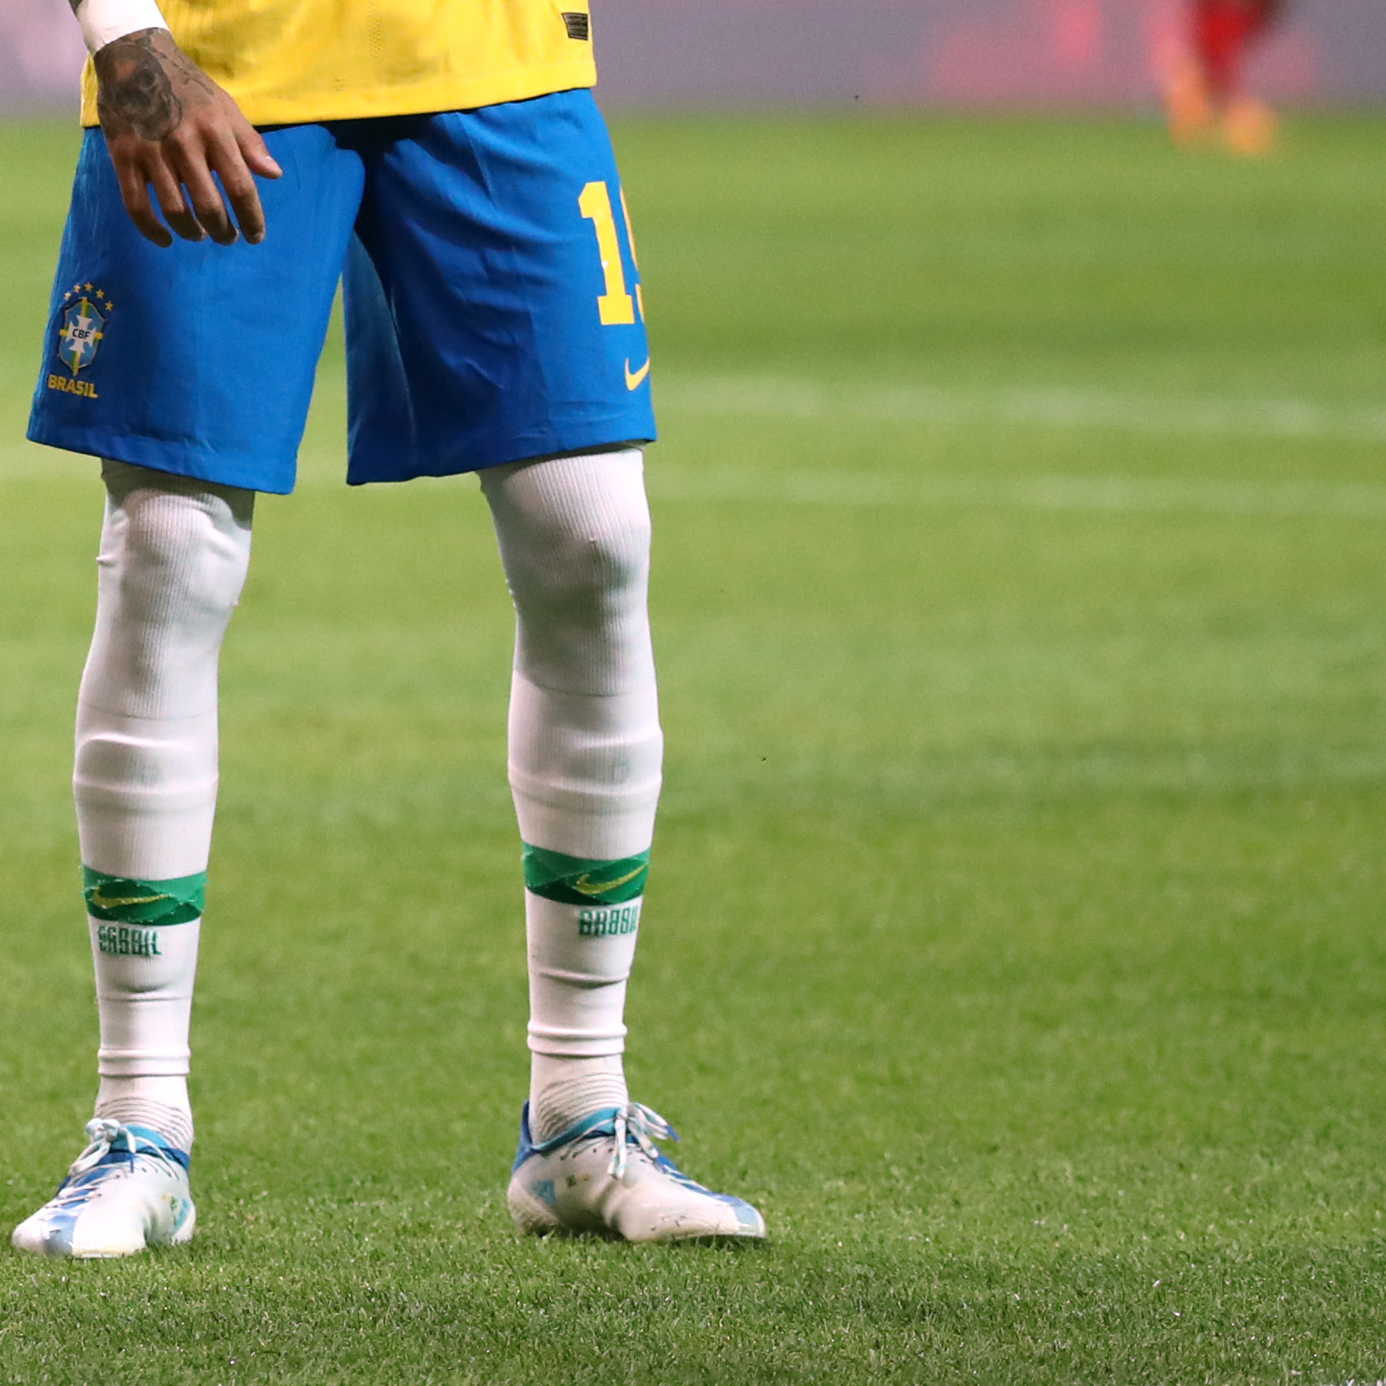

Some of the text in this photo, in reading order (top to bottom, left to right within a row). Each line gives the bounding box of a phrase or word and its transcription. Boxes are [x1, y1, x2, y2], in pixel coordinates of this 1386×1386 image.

[578, 181, 646, 326] 1
[72, 328, 91, 340] CBF
[47, 374, 98, 399] BRASIL
